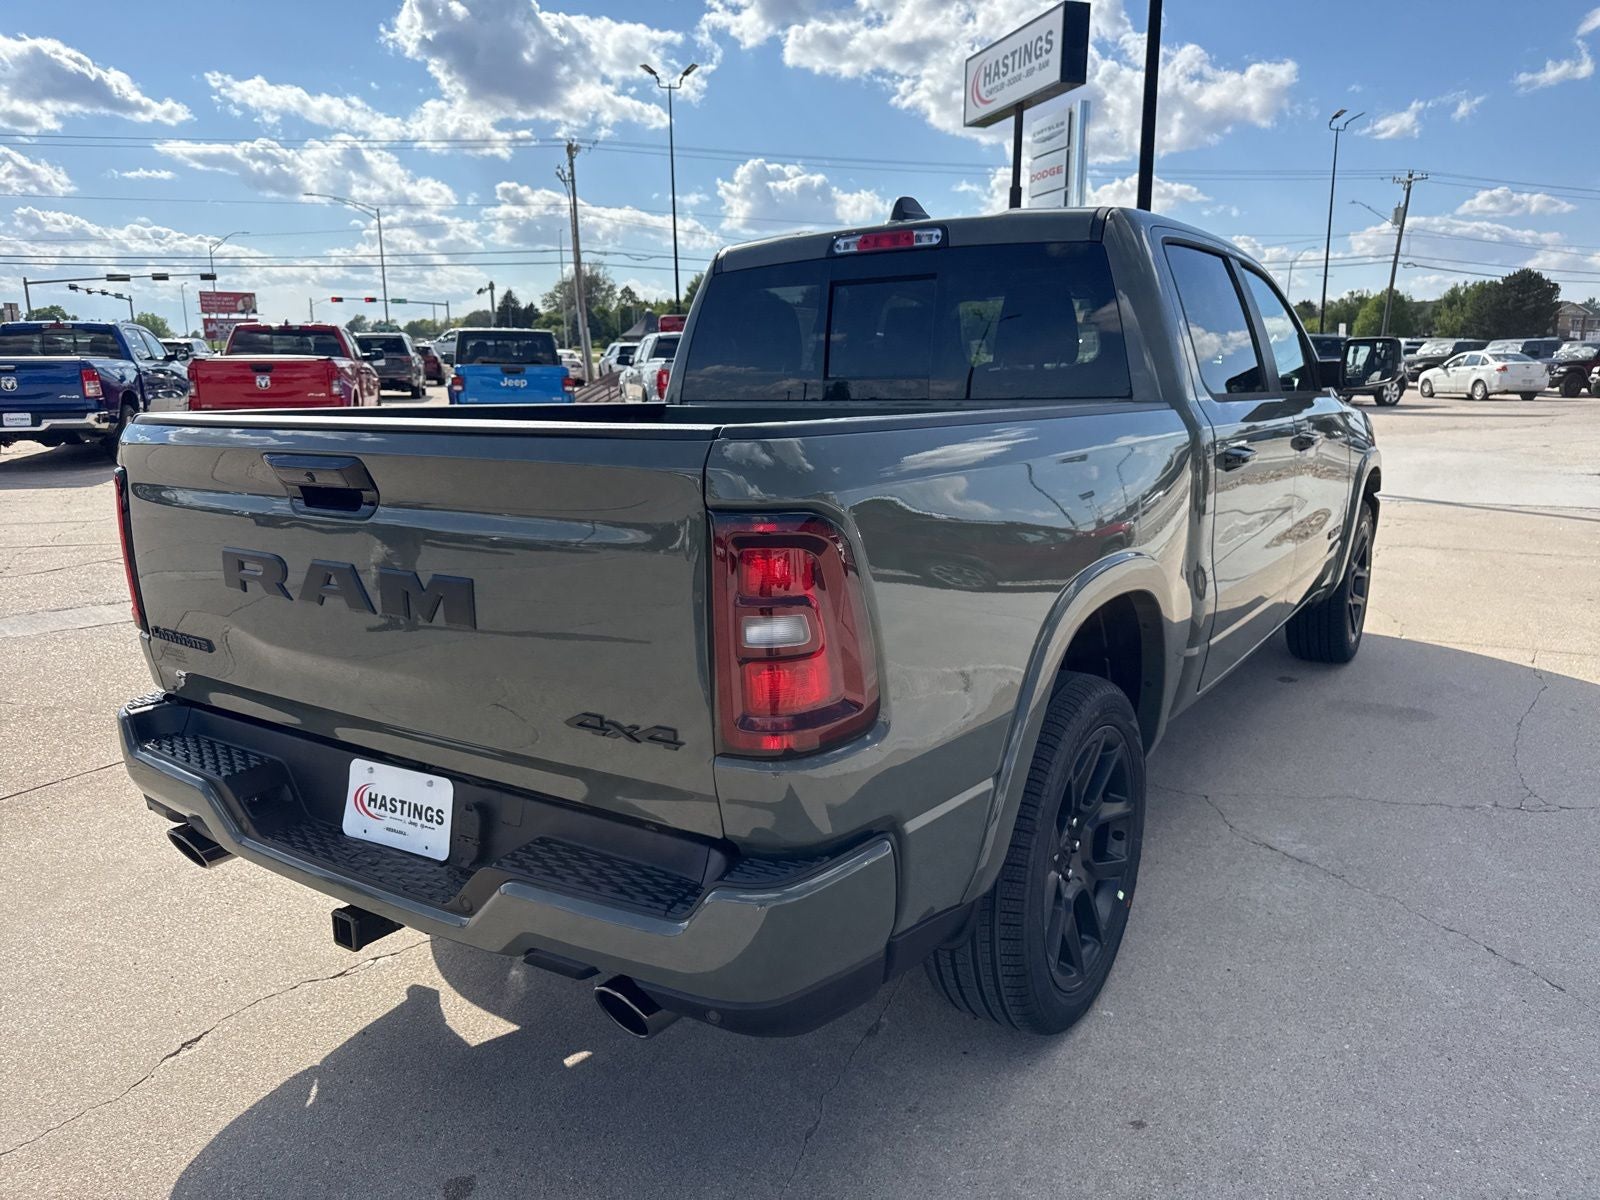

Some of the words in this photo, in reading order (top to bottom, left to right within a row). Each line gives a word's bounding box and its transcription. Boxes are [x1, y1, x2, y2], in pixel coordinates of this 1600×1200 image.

[983, 29, 1054, 88] HASTINGS
[1032, 121, 1065, 138] CHRYSLER
[1030, 164, 1064, 184] DODGE
[500, 377, 528, 388] Jeep
[222, 546, 477, 630] RAM
[367, 791, 445, 826] HASTINGS
